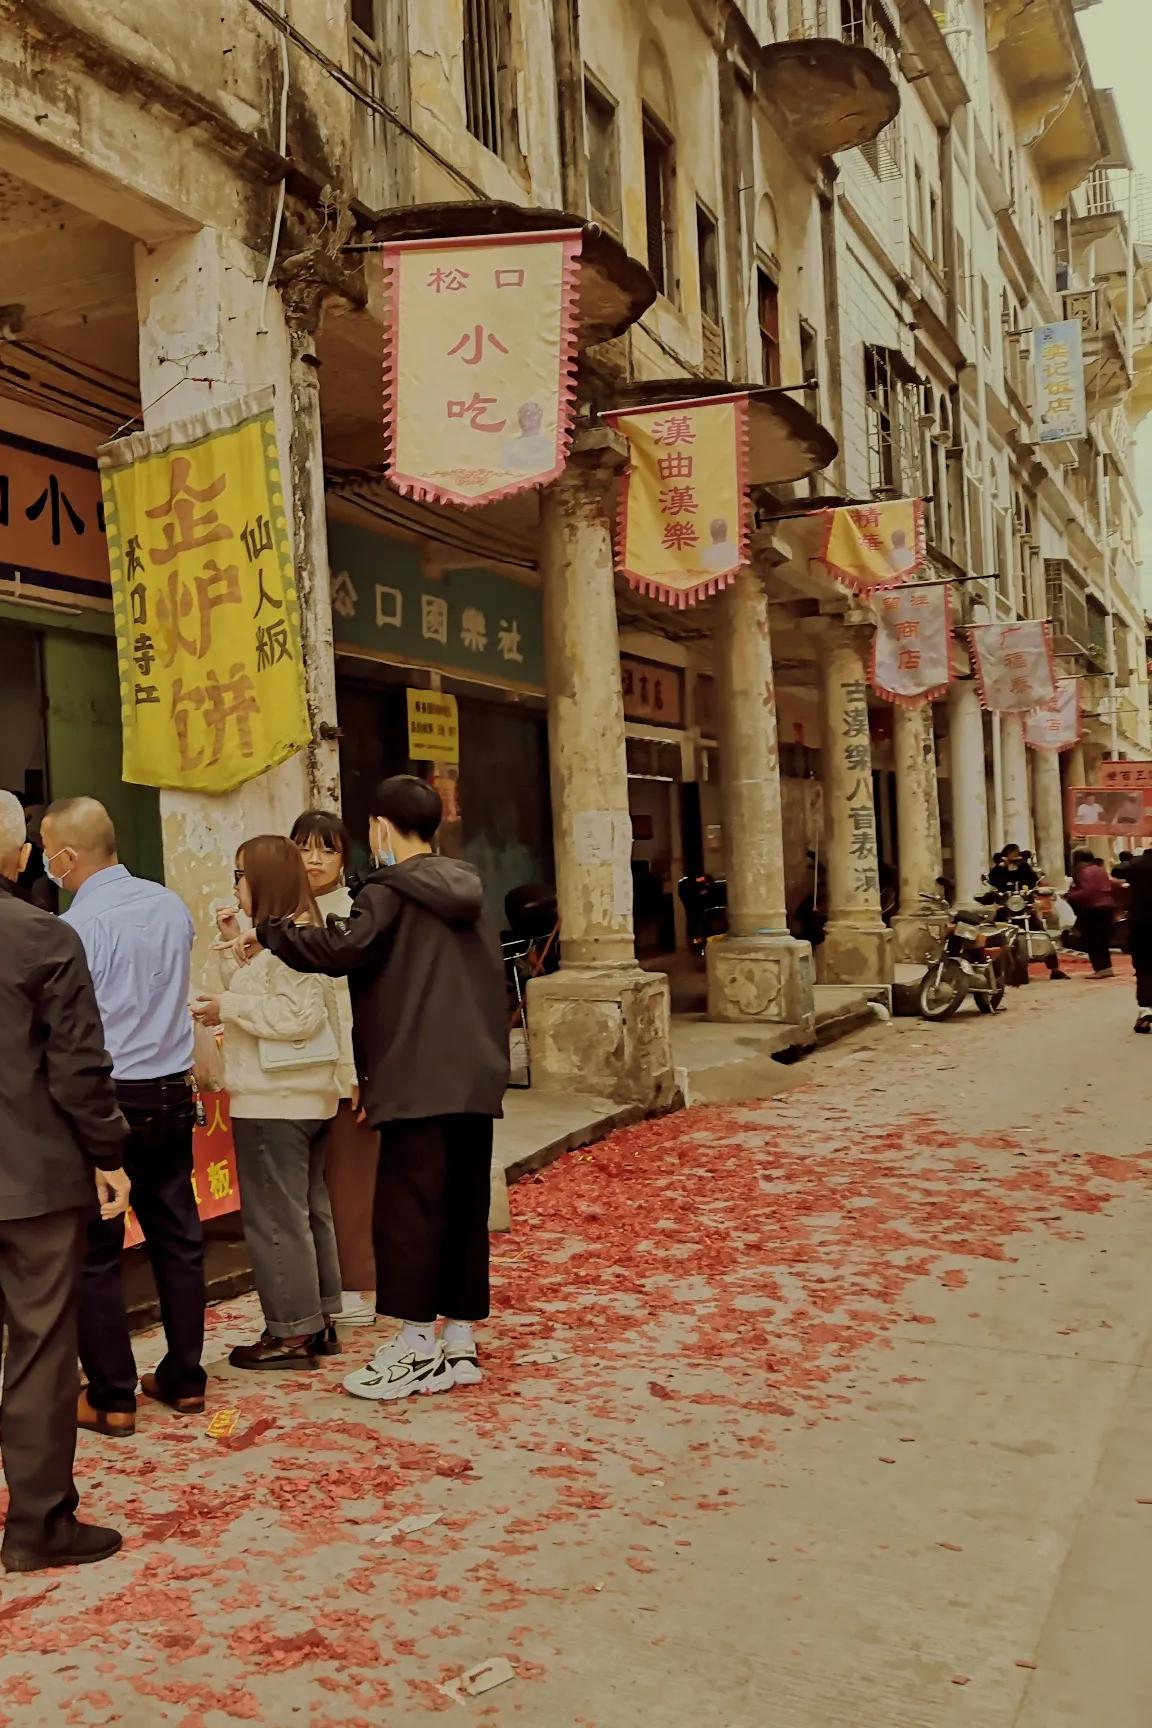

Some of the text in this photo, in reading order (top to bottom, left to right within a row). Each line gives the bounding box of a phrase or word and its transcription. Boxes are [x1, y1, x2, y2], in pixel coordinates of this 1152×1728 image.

[427, 267, 525, 294] 松口
[447, 325, 509, 433] 小吃
[651, 416, 699, 551] 漢曲漢樂
[146, 457, 260, 771] 企炉饼
[240, 515, 293, 673] 仙人粄
[894, 621, 921, 670] 商店
